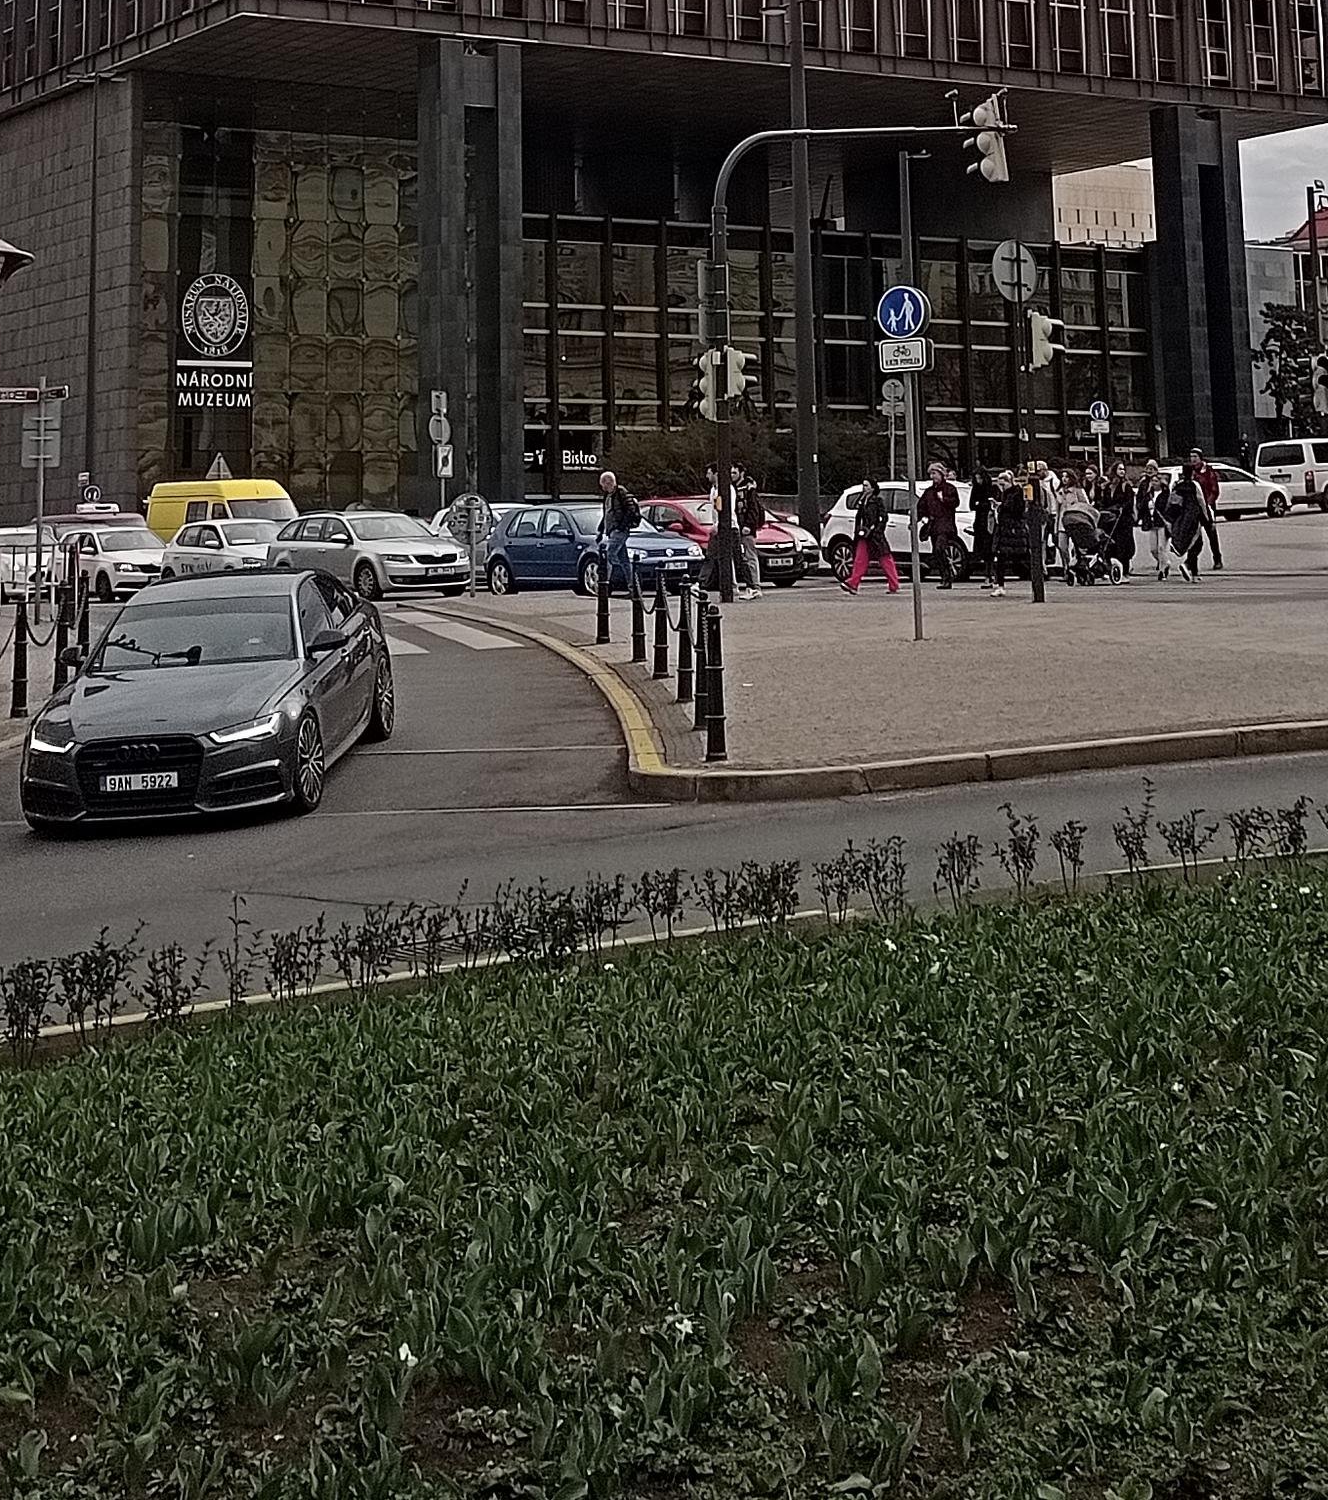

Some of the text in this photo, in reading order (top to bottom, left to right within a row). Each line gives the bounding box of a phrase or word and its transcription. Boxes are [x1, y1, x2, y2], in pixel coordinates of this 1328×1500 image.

[176, 371, 253, 388] NÁRODNÍ
[177, 392, 252, 407] MUZEUM
[562, 449, 597, 464] Bistro
[109, 774, 173, 791] 9AN 5922
